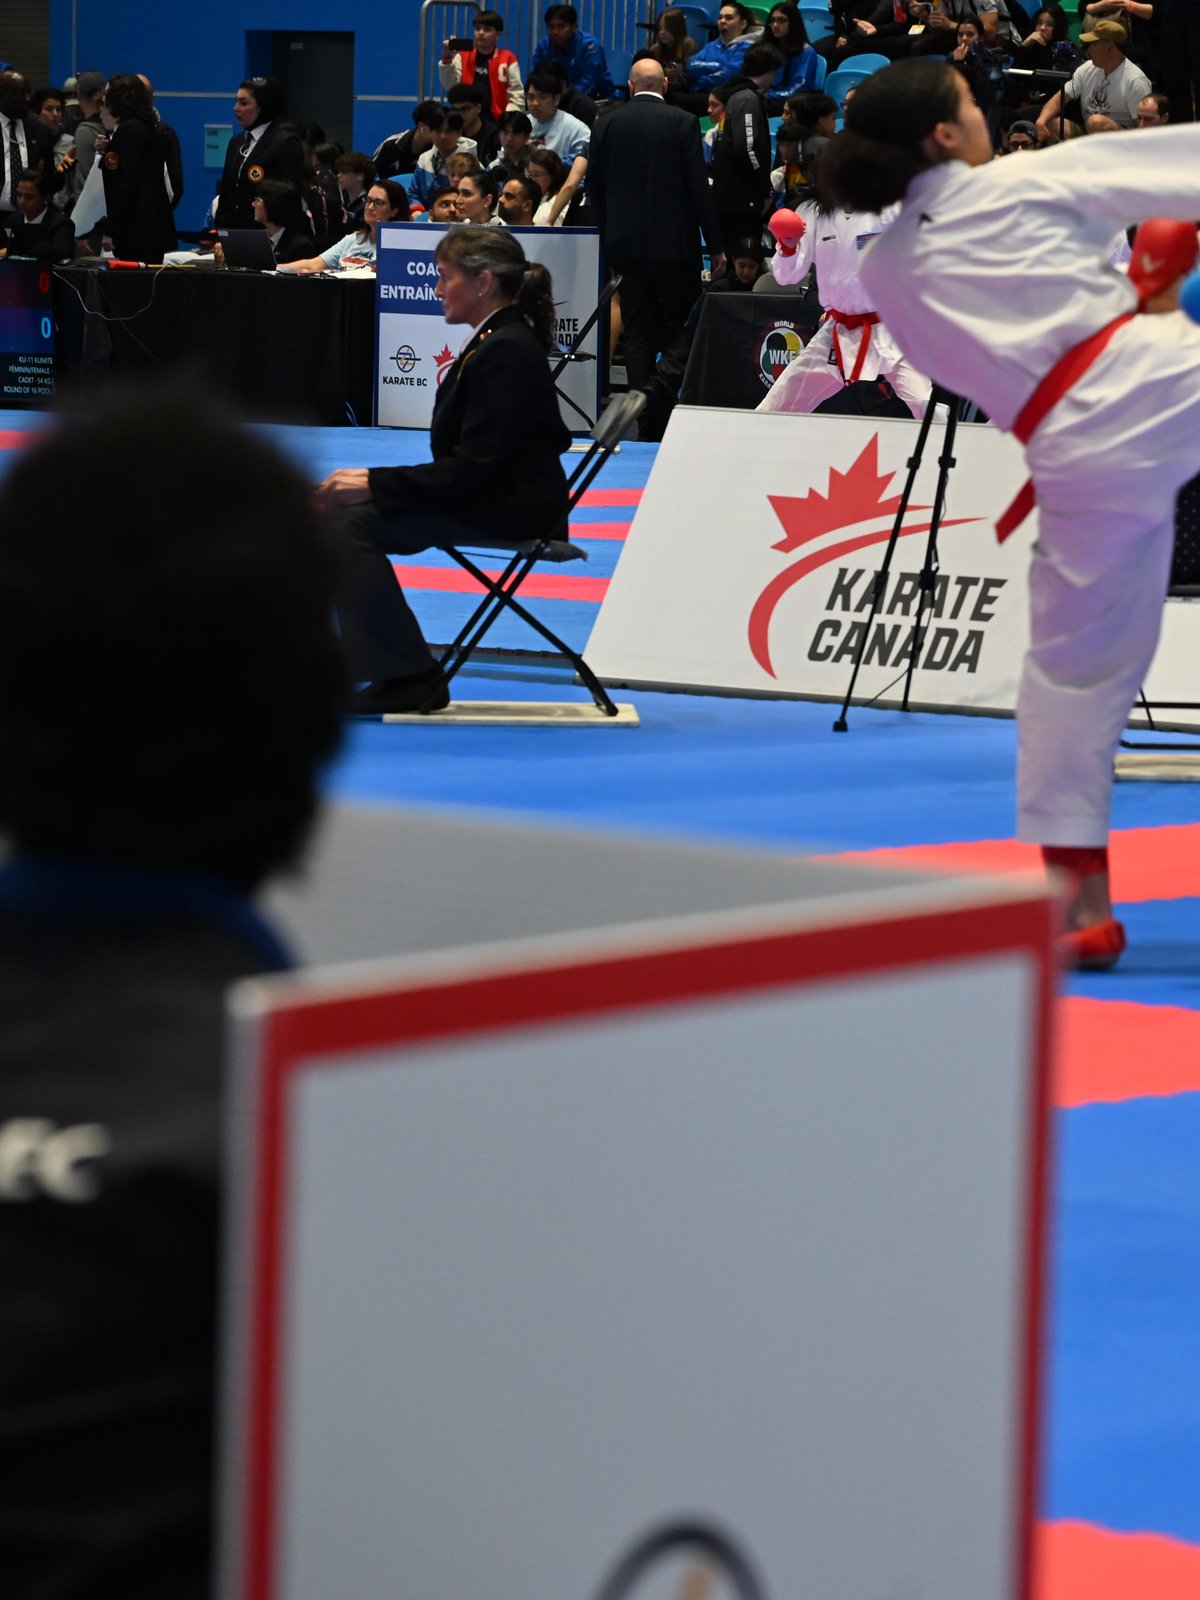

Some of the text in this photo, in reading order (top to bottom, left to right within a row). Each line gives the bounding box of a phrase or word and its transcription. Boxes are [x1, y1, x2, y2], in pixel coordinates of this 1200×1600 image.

[380, 283, 444, 301] ENTRAÎN
[41, 317, 51, 338] 0
[774, 320, 795, 329] WORLD
[769, 349, 796, 365] WKF
[4, 385, 22, 393] ROUND
[382, 376, 427, 386] KARATE BC
[825, 567, 1008, 622] KARATE
[807, 619, 985, 673] CANADA
